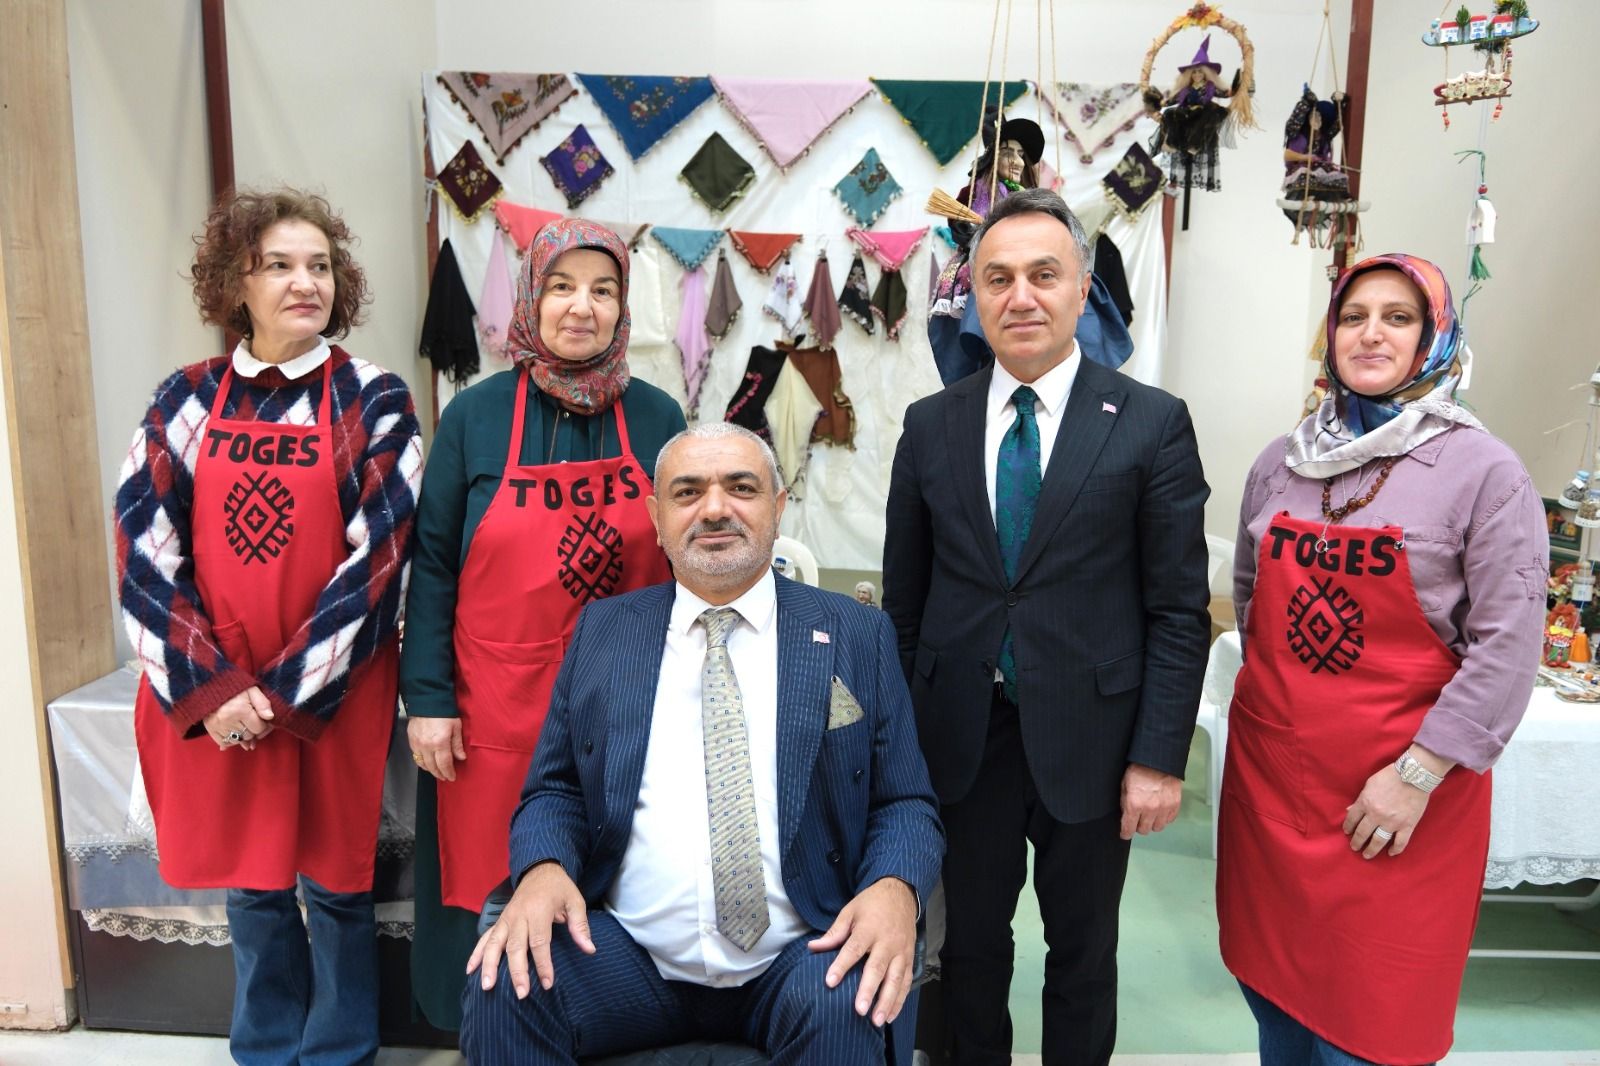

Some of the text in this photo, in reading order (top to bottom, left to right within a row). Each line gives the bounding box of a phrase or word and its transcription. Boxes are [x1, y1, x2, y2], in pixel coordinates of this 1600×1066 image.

[208, 429, 320, 467] TOGES
[508, 465, 640, 510] TOGES
[1269, 526, 1398, 577] TOGES
